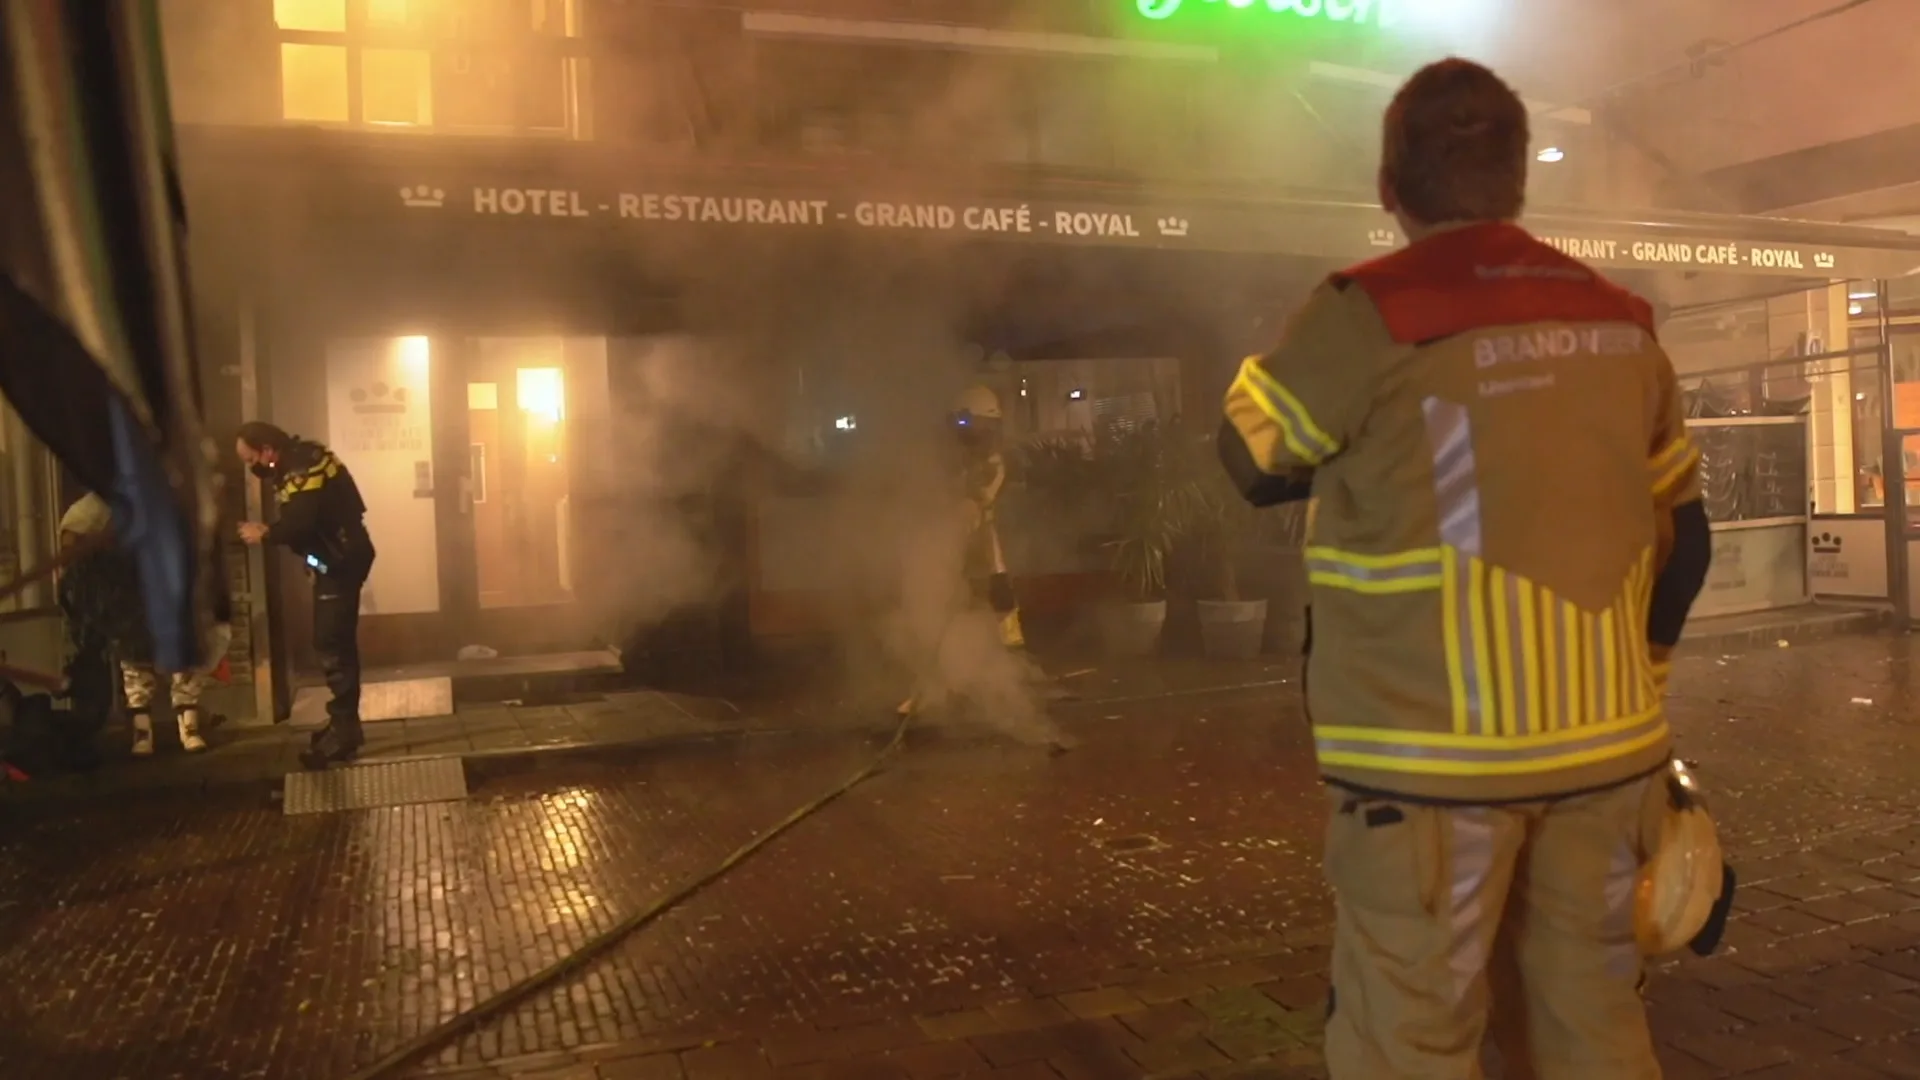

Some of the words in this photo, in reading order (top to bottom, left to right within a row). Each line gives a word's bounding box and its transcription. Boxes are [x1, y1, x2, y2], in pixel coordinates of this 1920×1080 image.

[473, 187, 589, 217] HOTEL
[619, 193, 828, 226] RESTAURANT
[855, 202, 956, 231] GRAND
[963, 205, 1032, 233] CAFÉ
[1055, 211, 1140, 237] ROYAL
[1533, 236, 1618, 260] AURANT
[1632, 241, 1692, 263] GRAND
[1696, 243, 1739, 266] CAFÉ
[1751, 250, 1804, 269] ROYAL
